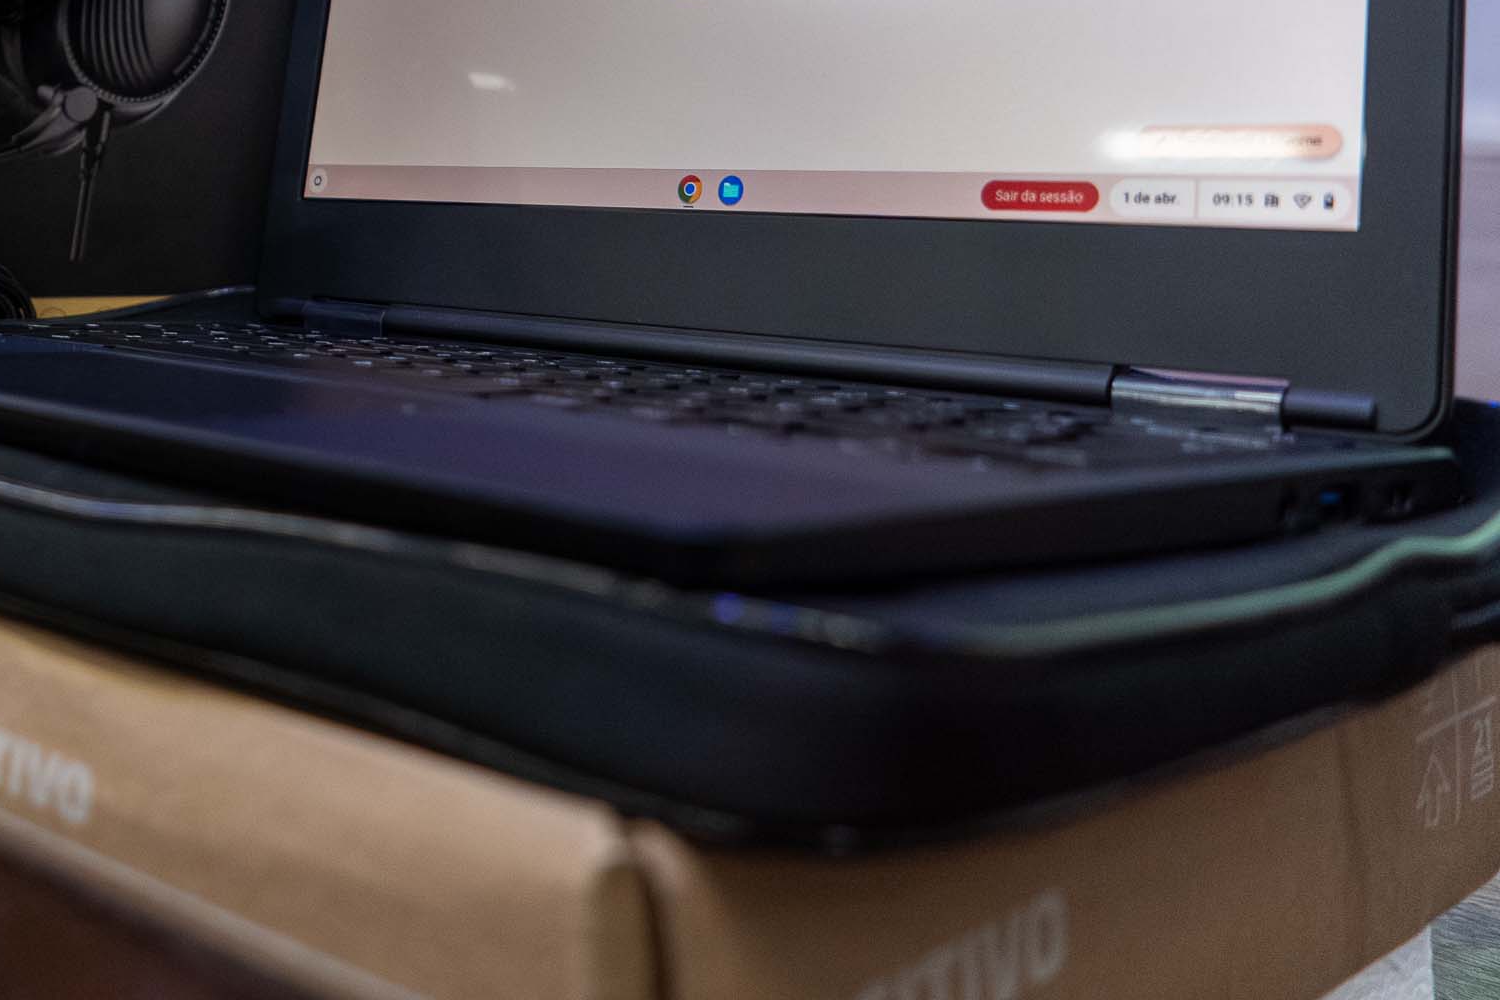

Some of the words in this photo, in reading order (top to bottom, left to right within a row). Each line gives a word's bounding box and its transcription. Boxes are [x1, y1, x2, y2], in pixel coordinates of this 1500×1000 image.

[995, 189, 1019, 202] Sair
[1020, 189, 1036, 203] da
[1039, 189, 1084, 205] sessão
[1123, 191, 1130, 202] 1
[1133, 191, 1151, 203] de
[1212, 193, 1253, 206] 09:15
